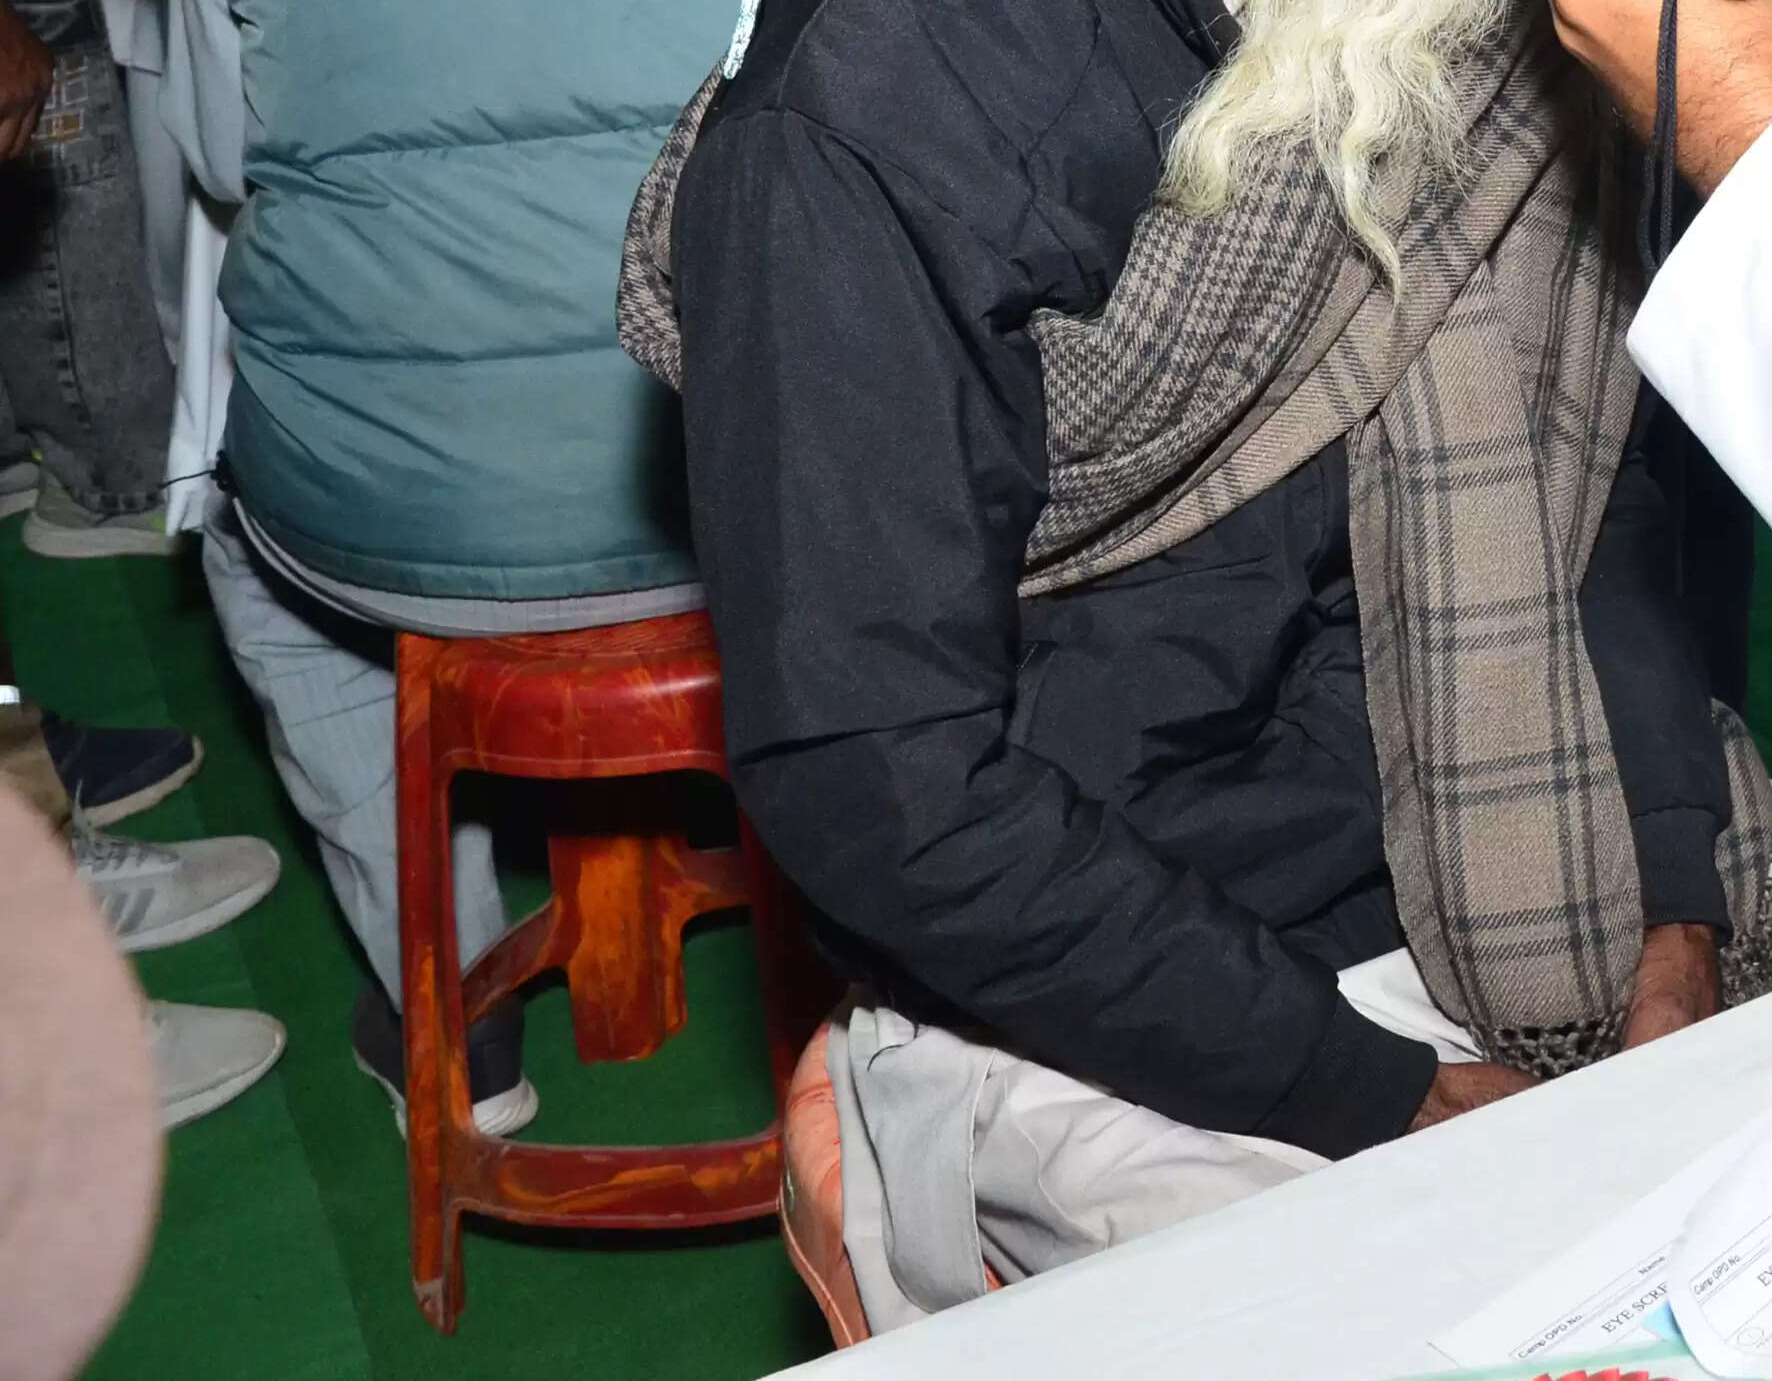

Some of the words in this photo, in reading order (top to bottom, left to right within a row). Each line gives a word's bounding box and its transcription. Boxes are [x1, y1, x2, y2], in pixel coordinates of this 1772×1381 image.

[1694, 1277, 1715, 1296] Camp
[1713, 1261, 1730, 1280] OPD
[1601, 1309, 1634, 1333] EYE
[1518, 1336, 1546, 1359] Camp
[1544, 1320, 1568, 1340] OPD
